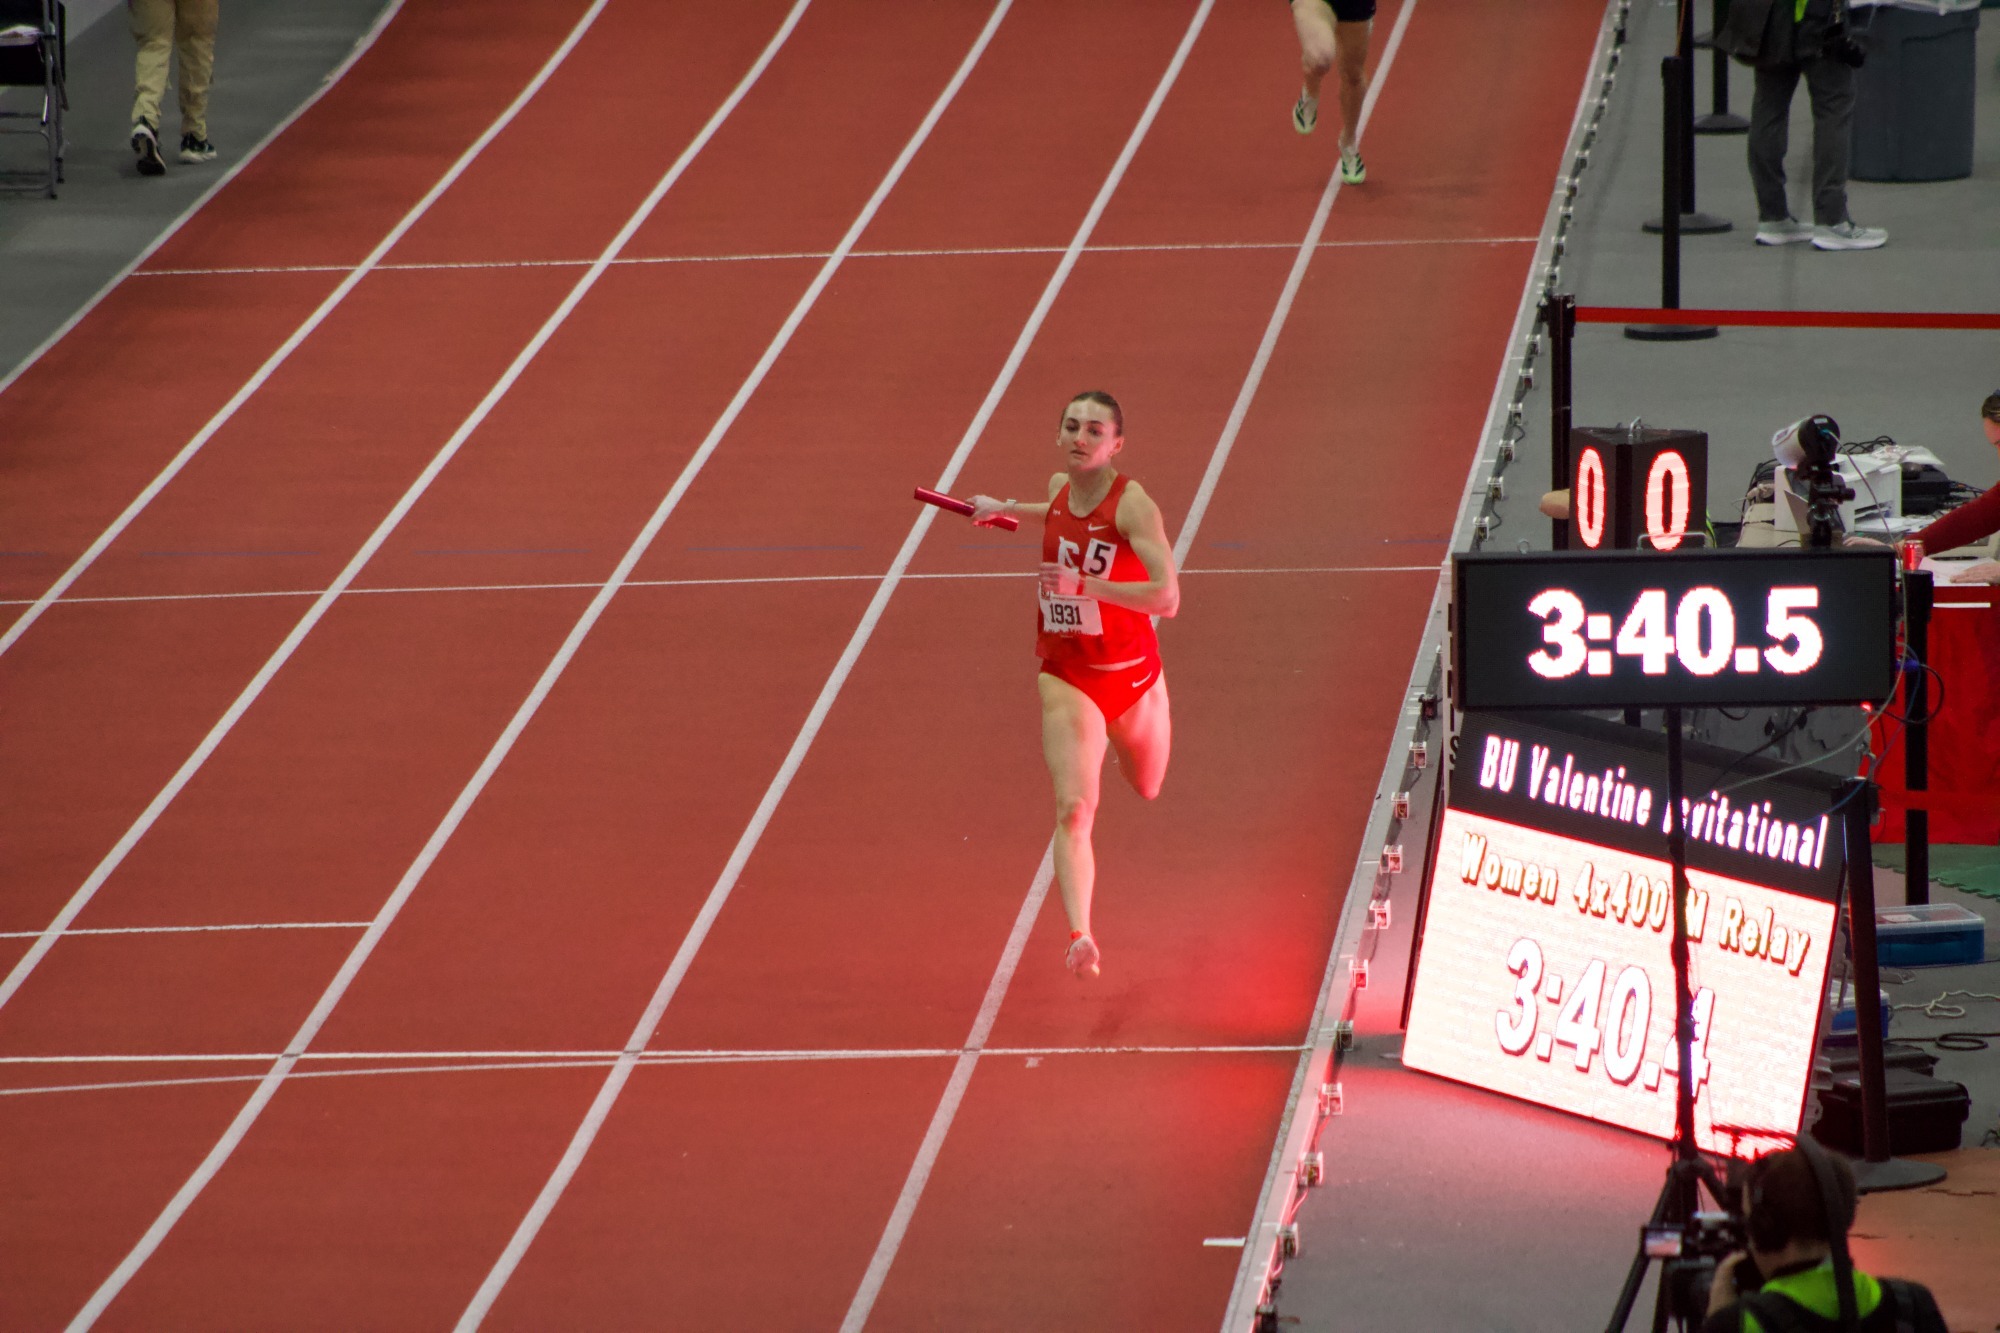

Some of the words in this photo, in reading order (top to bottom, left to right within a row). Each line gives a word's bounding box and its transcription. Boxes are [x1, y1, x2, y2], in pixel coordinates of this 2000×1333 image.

[1577, 447, 1605, 548] 0
[1646, 449, 1690, 551] 0
[1089, 543, 1111, 575] 5
[1049, 603, 1082, 625] 1931
[1527, 586, 1823, 678] 3:40.5
[1480, 734, 1520, 793] BU
[1529, 744, 1652, 826] Valentine
[1461, 832, 1558, 905] Women
[1573, 861, 1670, 932] 4x400
[1685, 887, 1709, 942] M
[1719, 896, 1810, 976] Relay
[1495, 937, 1715, 1104] 3:40.4
